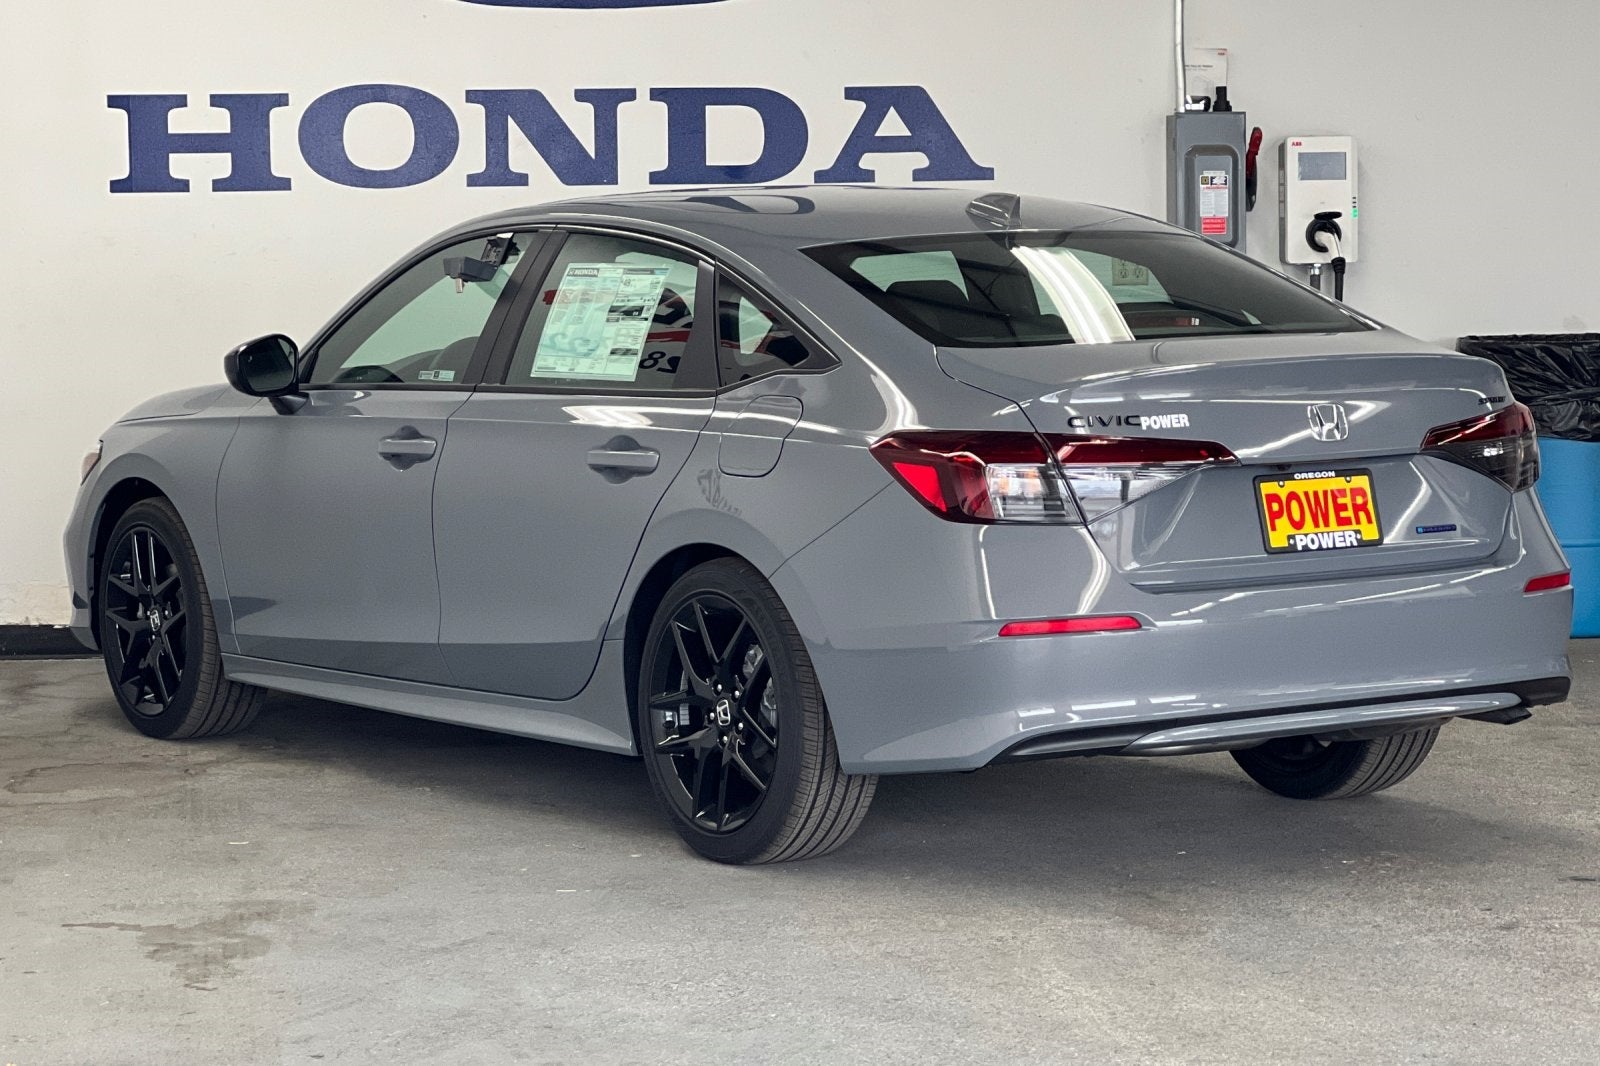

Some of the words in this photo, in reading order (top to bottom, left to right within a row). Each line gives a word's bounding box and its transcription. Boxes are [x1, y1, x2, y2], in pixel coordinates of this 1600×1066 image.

[106, 84, 995, 194] HONDA
[573, 268, 598, 276] HONDA
[1067, 414, 1141, 428] CIVIC
[1140, 413, 1190, 431] POWER
[1293, 470, 1336, 480] OREGON
[1264, 486, 1373, 532] POWER
[1295, 530, 1359, 551] POWER
